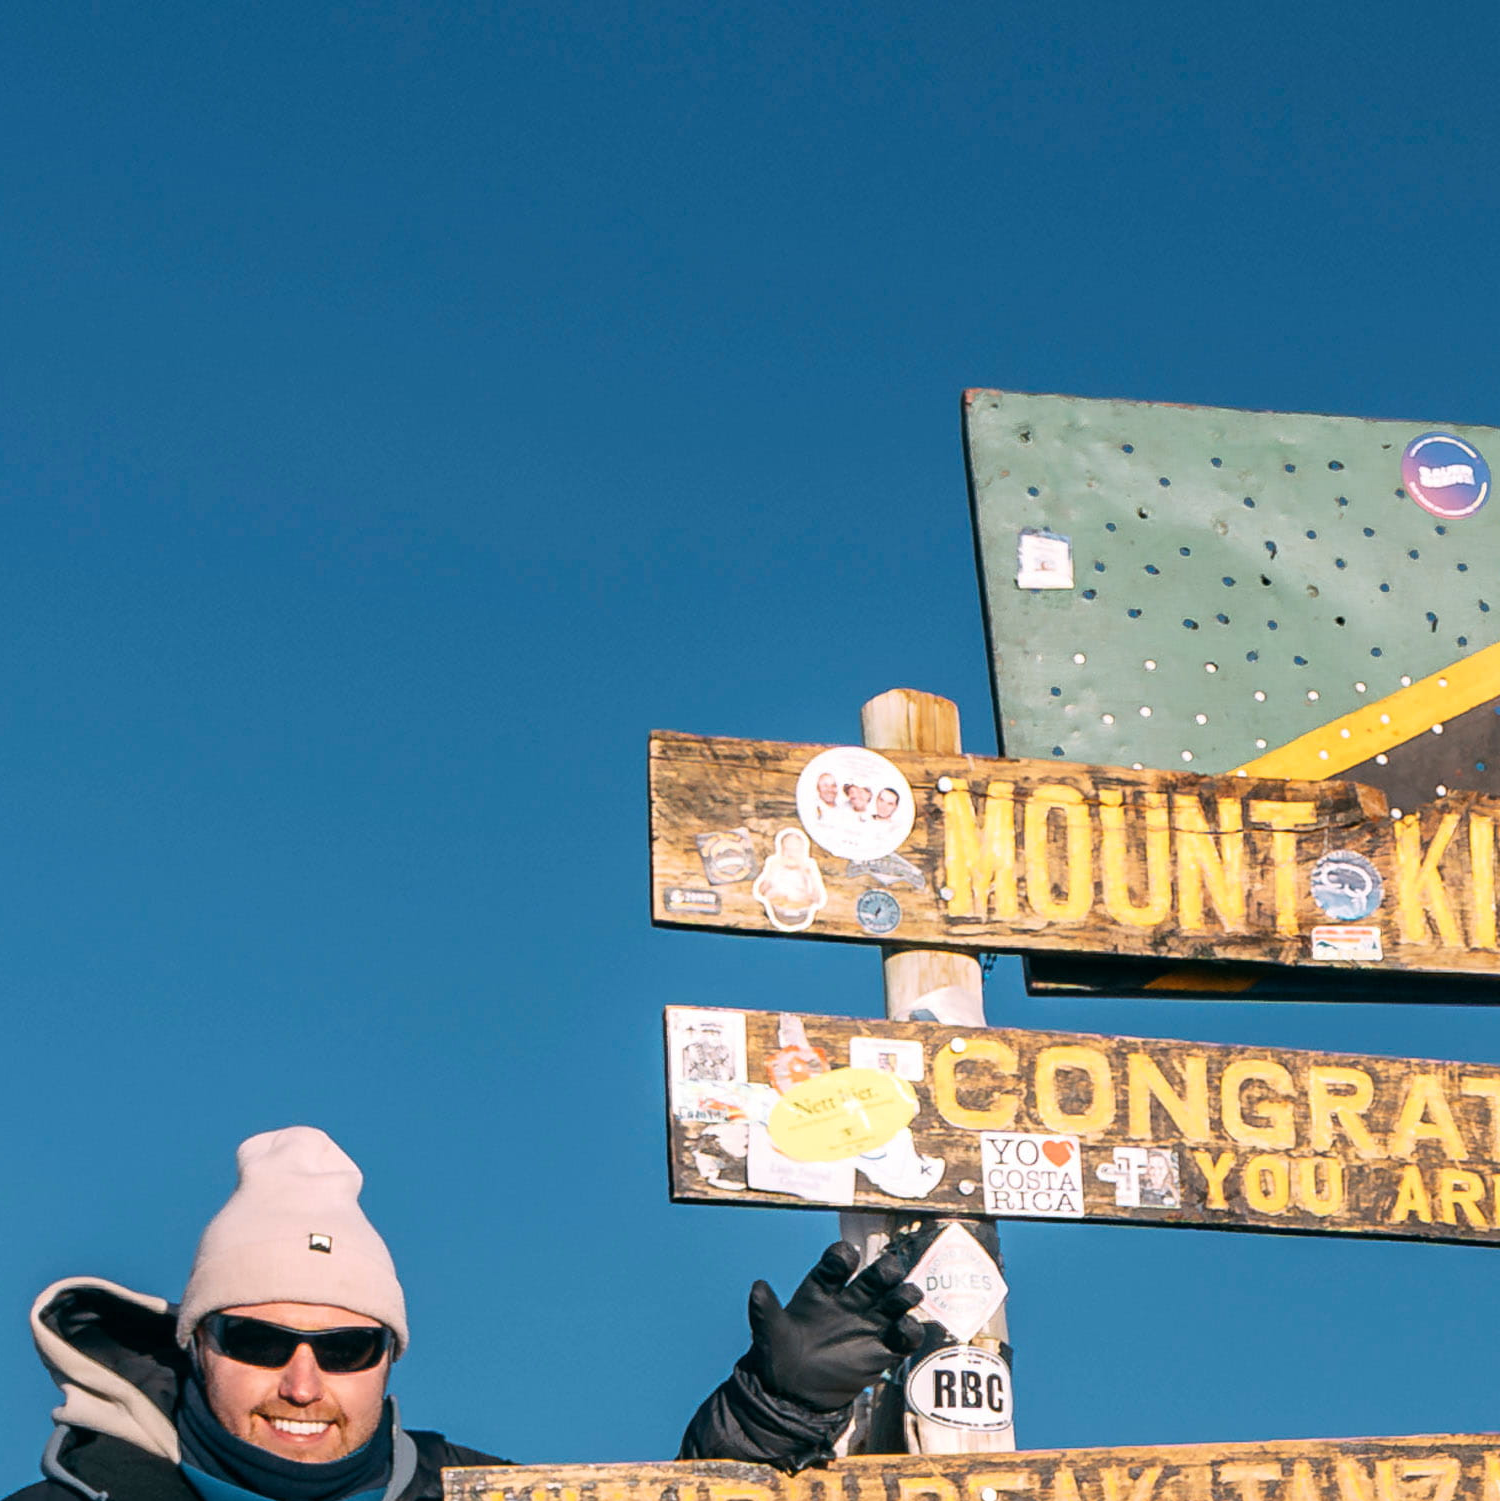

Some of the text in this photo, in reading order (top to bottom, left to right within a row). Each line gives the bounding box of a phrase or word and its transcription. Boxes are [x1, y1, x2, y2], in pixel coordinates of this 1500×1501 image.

[944, 780, 1318, 936] MOUNT
[987, 1138, 1040, 1167] YO
[987, 1168, 1079, 1192] COSTA
[1193, 1151, 1345, 1216] YOU
[990, 1191, 1080, 1213] RICA
[925, 1274, 992, 1292] DUKES
[933, 1369, 1004, 1413] RBC
